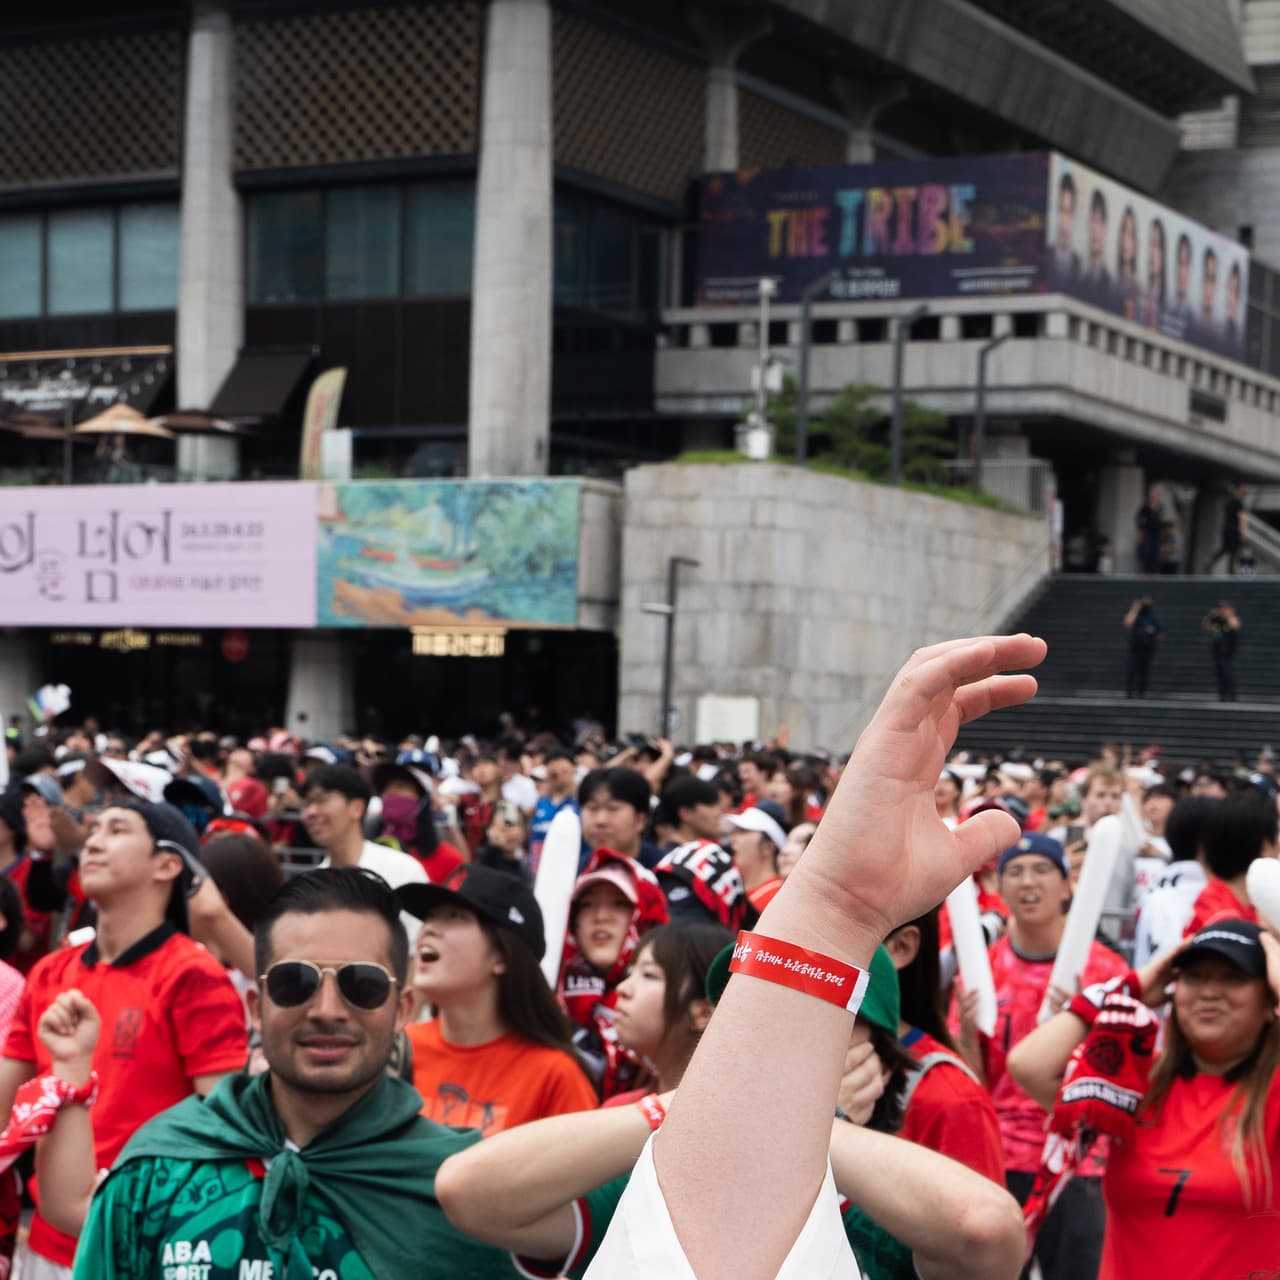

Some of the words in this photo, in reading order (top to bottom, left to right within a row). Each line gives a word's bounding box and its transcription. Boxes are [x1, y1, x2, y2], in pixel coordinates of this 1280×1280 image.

[767, 205, 830, 258] THE
[836, 183, 976, 259] TRIBE
[825, 971, 847, 988] 2026
[1156, 1167, 1193, 1218] 7
[162, 1239, 212, 1267] ABA
